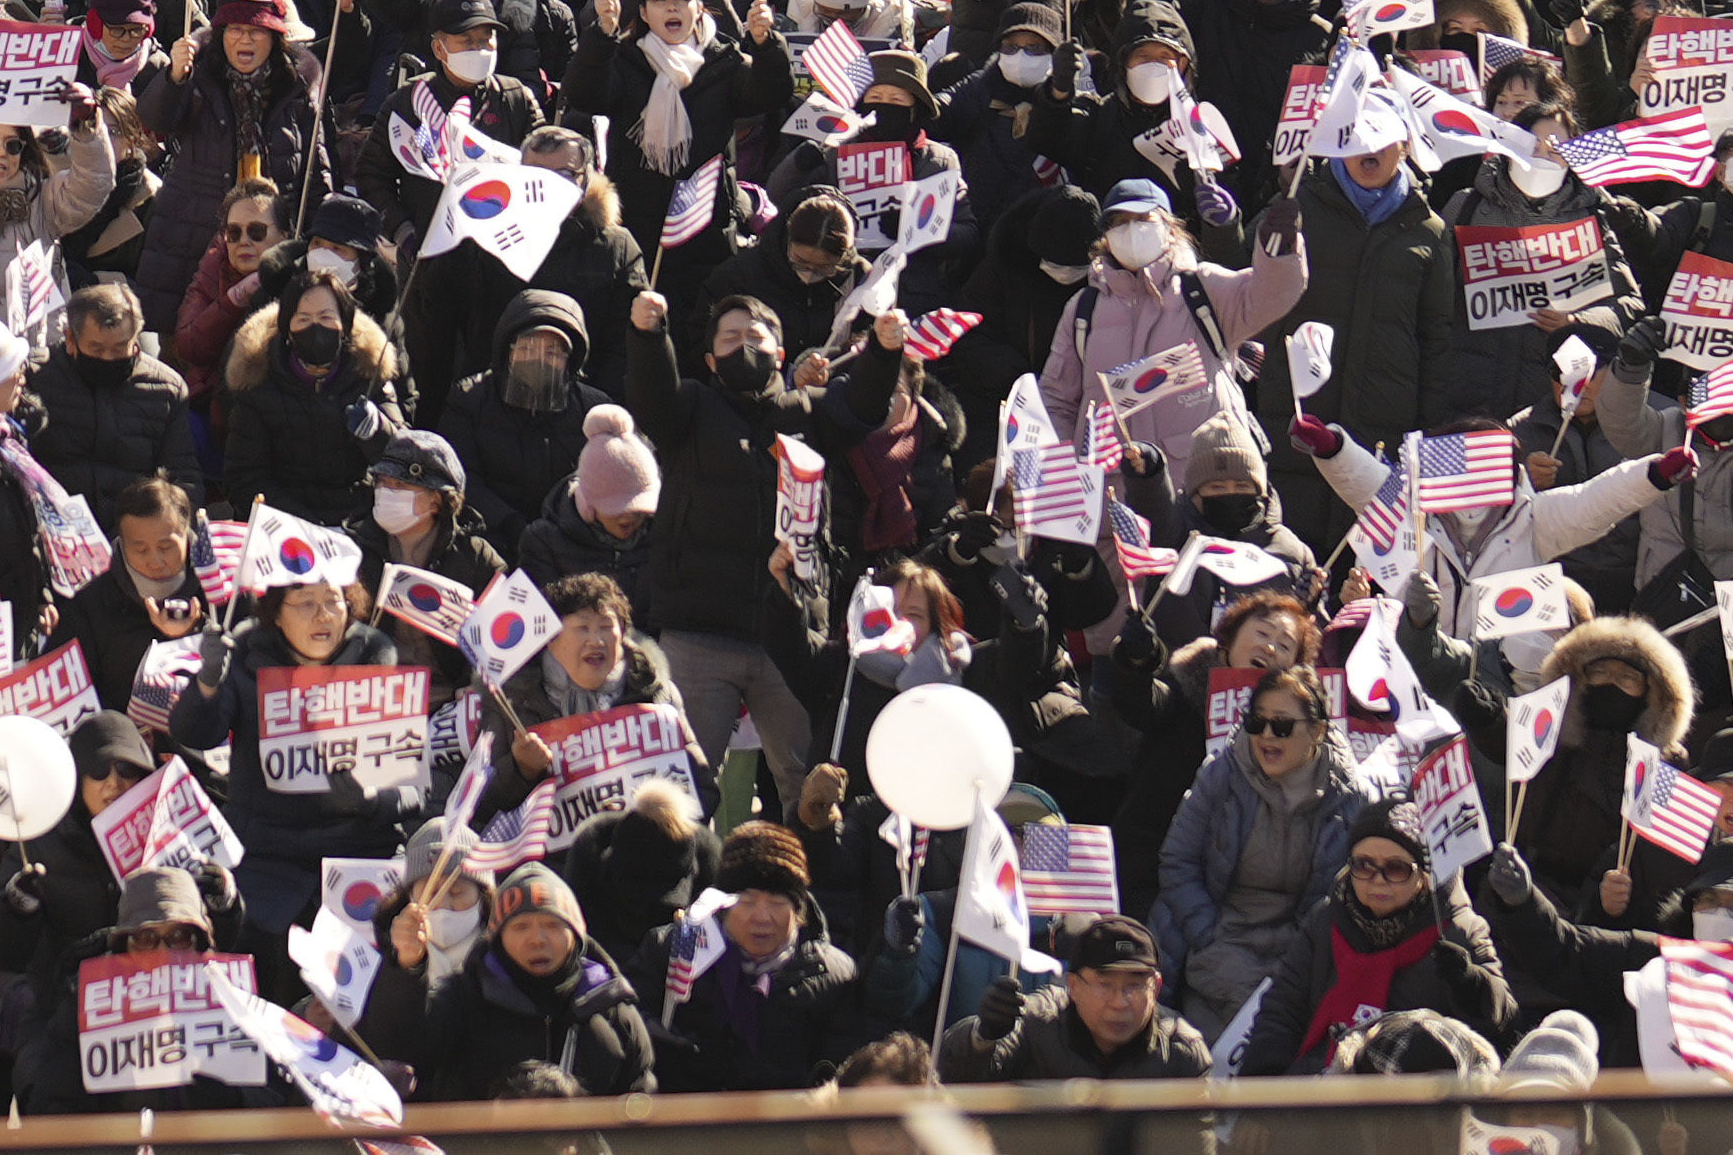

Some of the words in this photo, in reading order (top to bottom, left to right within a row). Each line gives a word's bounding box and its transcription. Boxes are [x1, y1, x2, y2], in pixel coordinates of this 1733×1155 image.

[13, 71, 69, 106] 구속
[1648, 71, 1727, 107] 이재명
[838, 147, 903, 192] 반대
[1467, 225, 1598, 280] 탄핵반대
[1470, 280, 1548, 319] 이재명
[1552, 260, 1605, 299] 구속
[1668, 271, 1733, 318] 탄핵
[264, 671, 428, 726] 탄핵반대
[267, 736, 358, 781] 이재명
[365, 731, 428, 762] 구속
[549, 775, 625, 841] 이재명
[88, 1030, 187, 1082] 이재명
